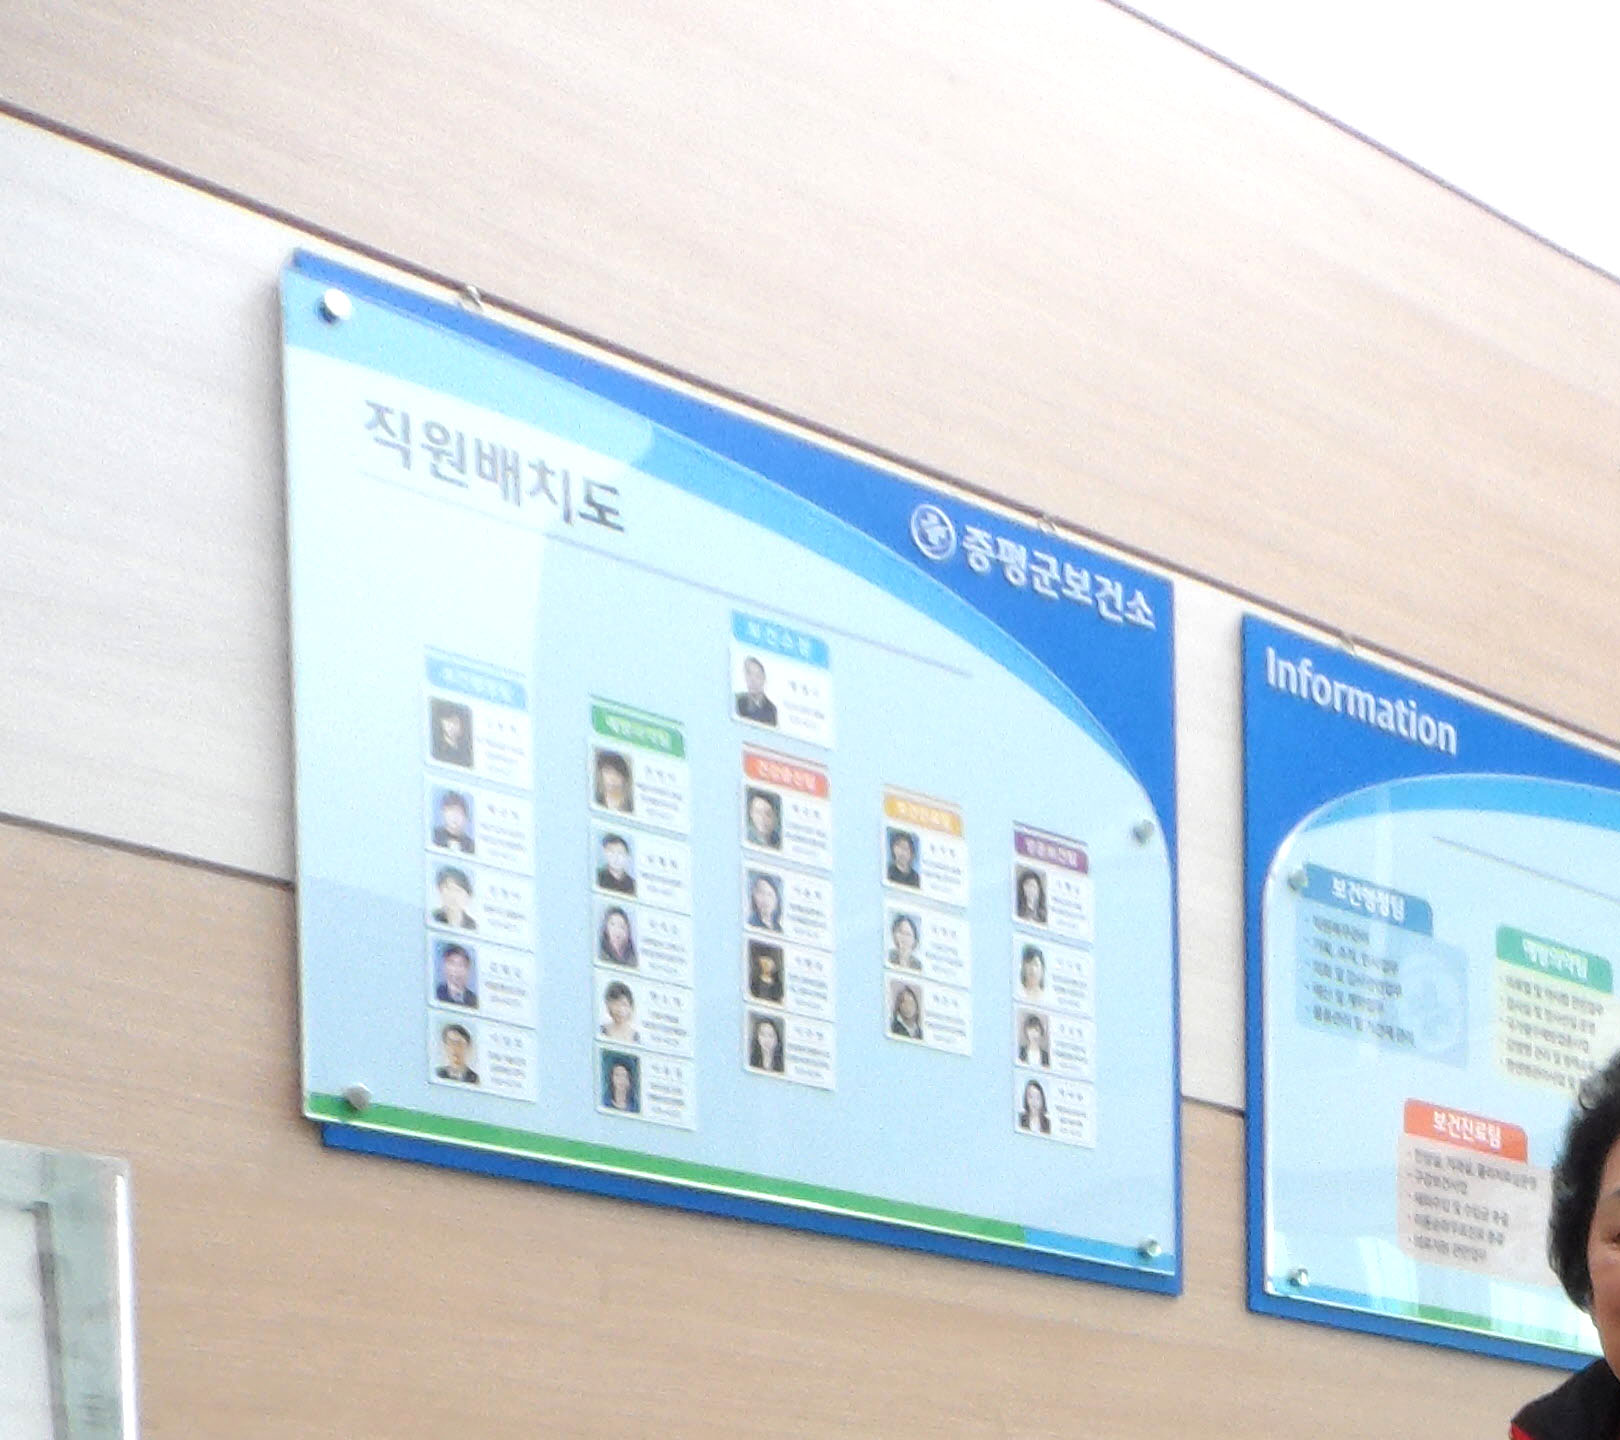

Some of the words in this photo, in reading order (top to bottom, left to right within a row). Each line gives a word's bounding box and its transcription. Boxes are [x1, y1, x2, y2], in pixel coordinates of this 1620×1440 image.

[362, 398, 626, 534] 직원배치도
[961, 524, 1157, 631] 증평군보건소
[1264, 646, 1458, 757] Information
[1433, 1111, 1502, 1149] 보건진료팀
